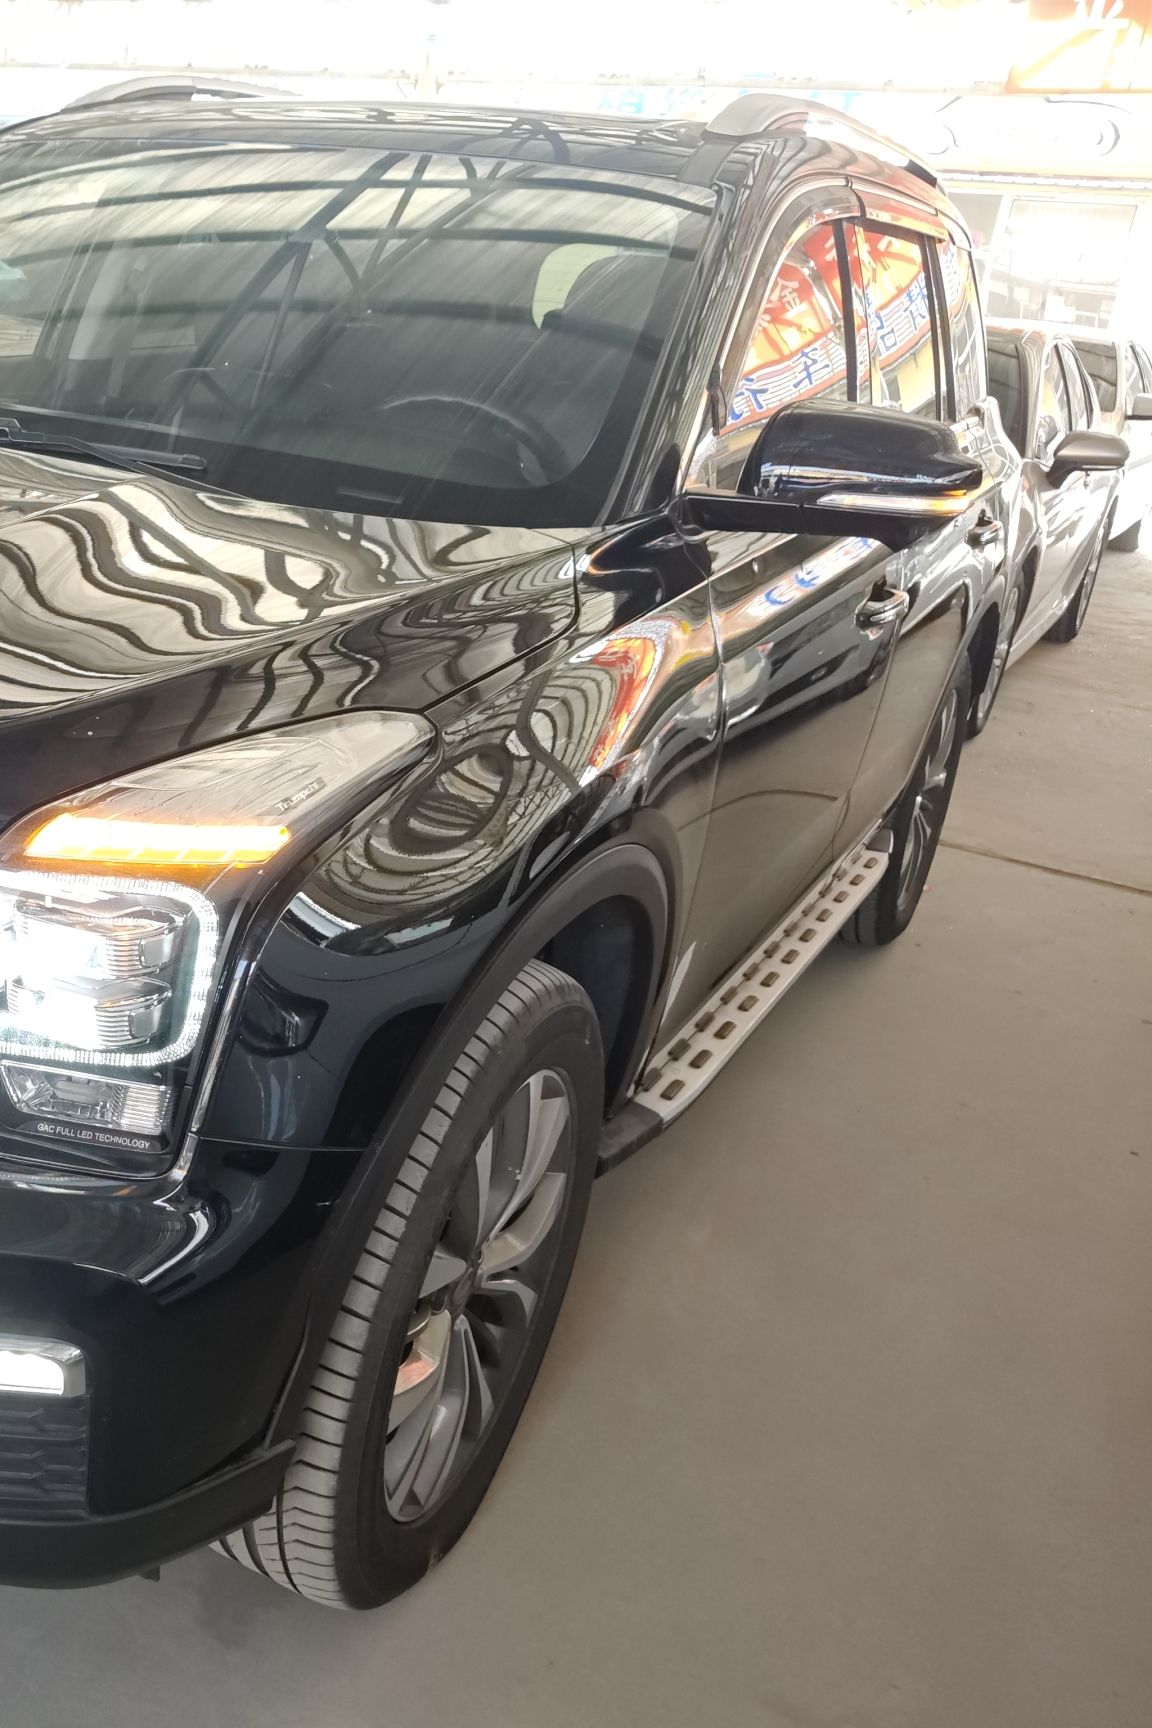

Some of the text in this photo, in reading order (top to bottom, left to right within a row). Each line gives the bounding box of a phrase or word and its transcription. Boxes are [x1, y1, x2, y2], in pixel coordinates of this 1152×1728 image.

[274, 781, 320, 812] Trumpchi
[37, 1123, 151, 1149] GAC FULL LED TECHNOLOGY
